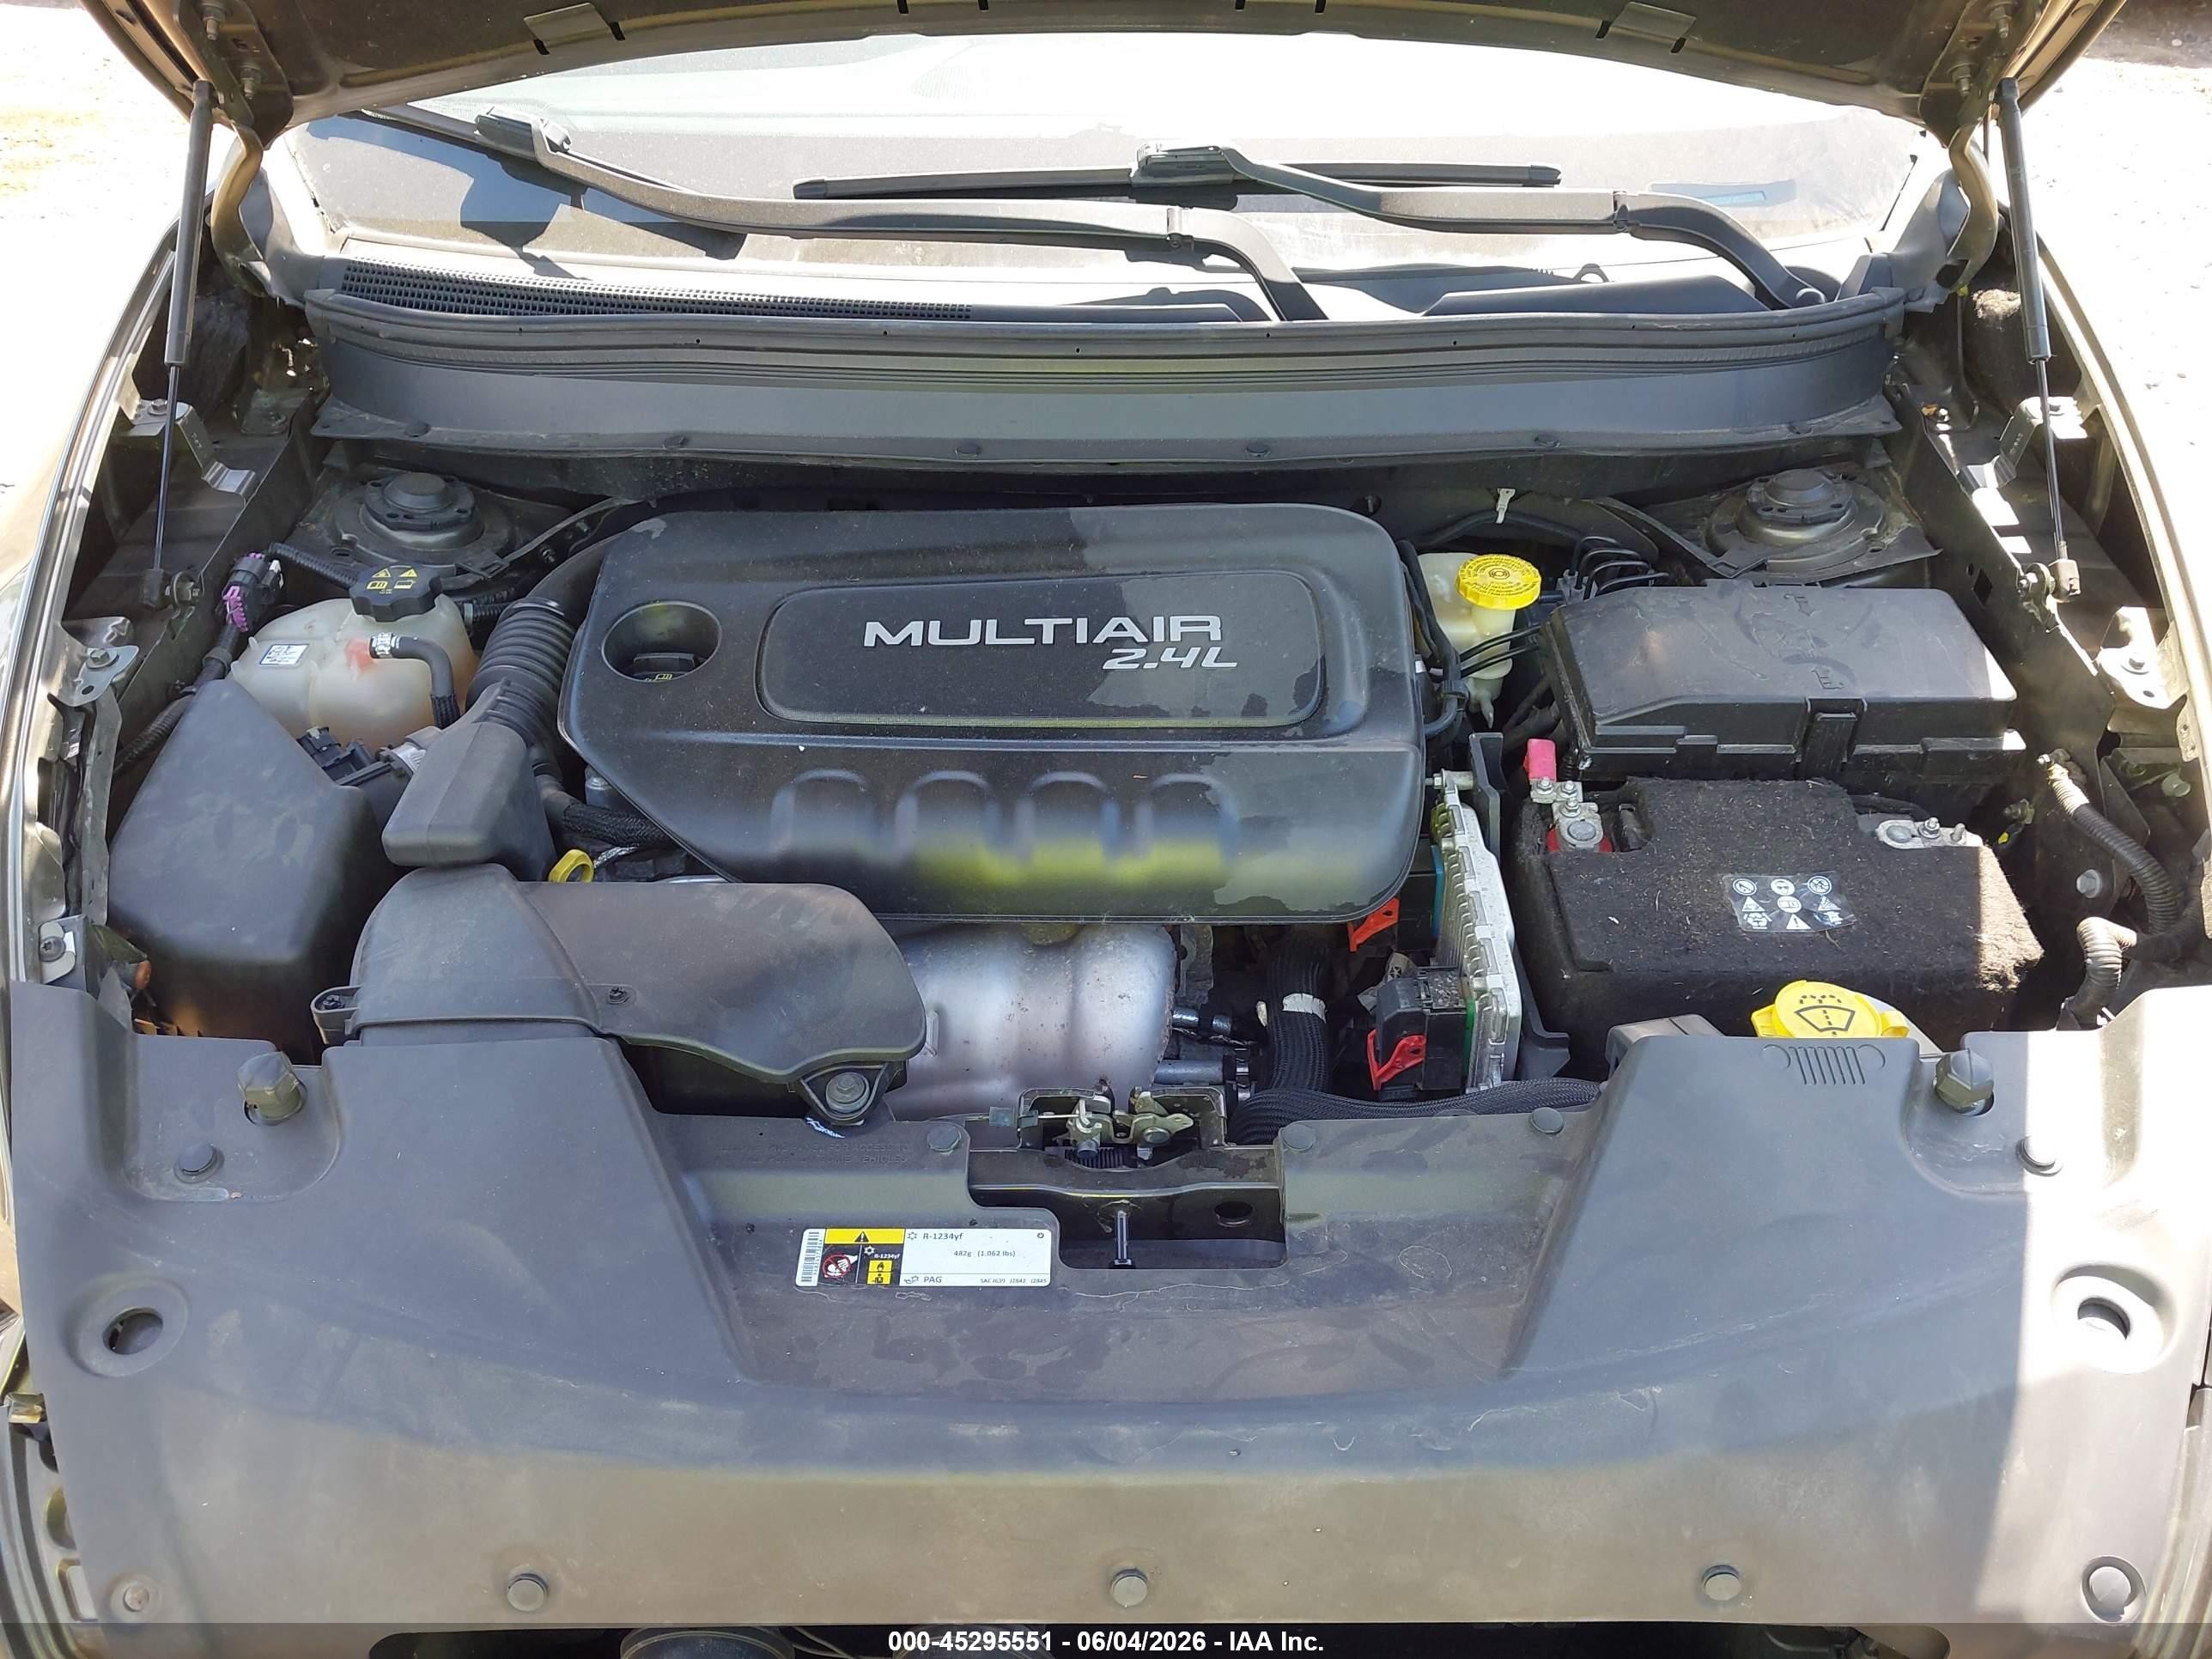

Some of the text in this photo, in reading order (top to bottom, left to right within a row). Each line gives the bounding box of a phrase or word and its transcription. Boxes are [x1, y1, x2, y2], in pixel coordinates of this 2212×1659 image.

[863, 615, 1223, 647] MULTIAIR
[1101, 646, 1238, 671] 2.4L
[922, 1232, 964, 1242] R-1234yf
[953, 1249, 1017, 1259] 482g (1.062 lbs)
[923, 1276, 943, 1285] PAG
